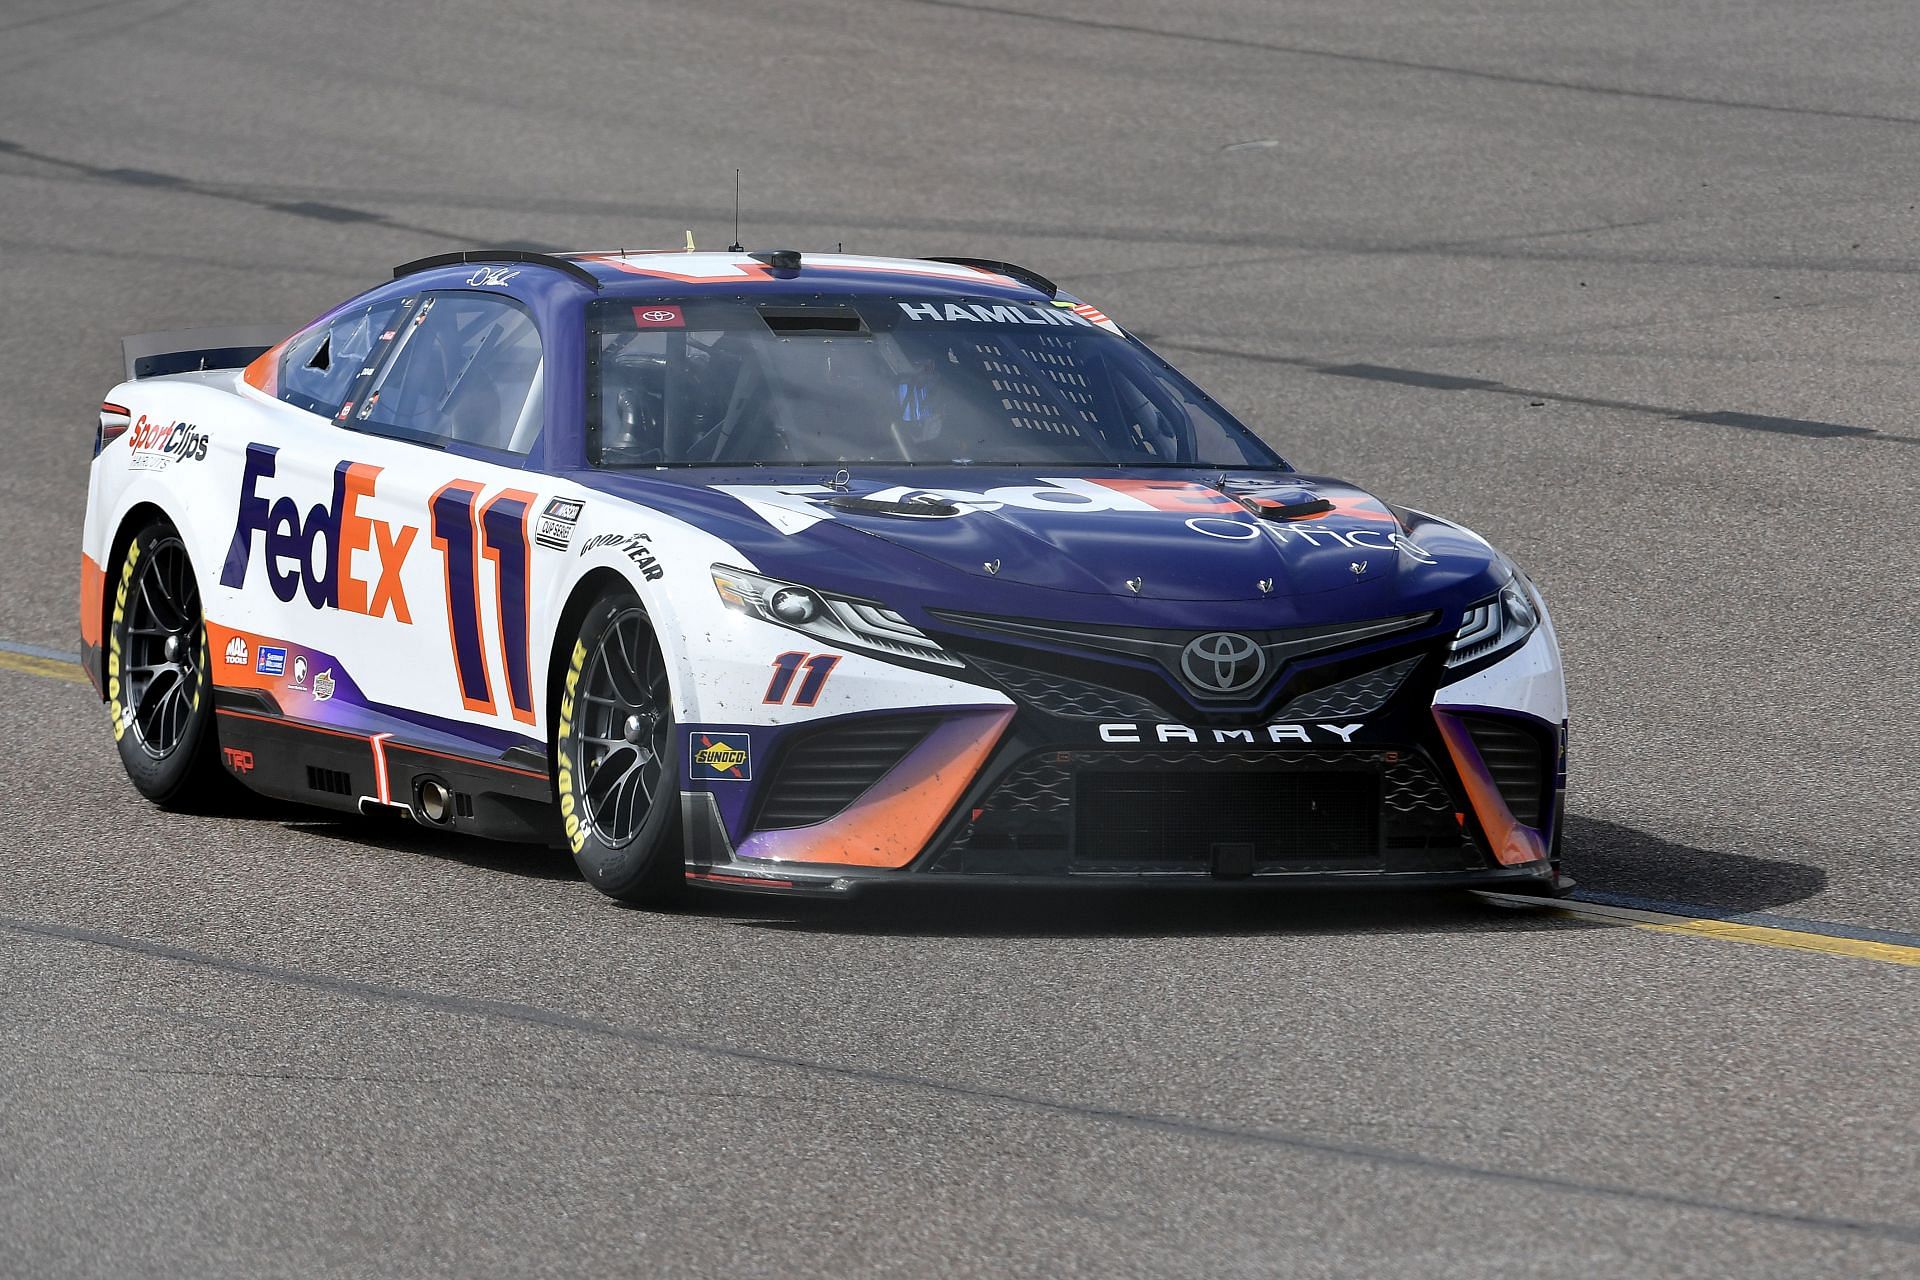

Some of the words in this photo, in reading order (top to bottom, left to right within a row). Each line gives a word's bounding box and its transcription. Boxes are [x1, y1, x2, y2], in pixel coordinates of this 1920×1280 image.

[897, 303, 1093, 328] HAMLIN
[220, 441, 419, 625] FedEx
[542, 521, 554, 535] CUP
[1184, 517, 1438, 565] Office
[428, 478, 538, 727] 11
[225, 637, 248, 656] MAC
[226, 655, 248, 665] TOOLS
[762, 651, 843, 707] 11
[1099, 723, 1364, 743] CAMRY
[224, 747, 254, 774] TRD
[697, 750, 745, 764] SUNOCO
